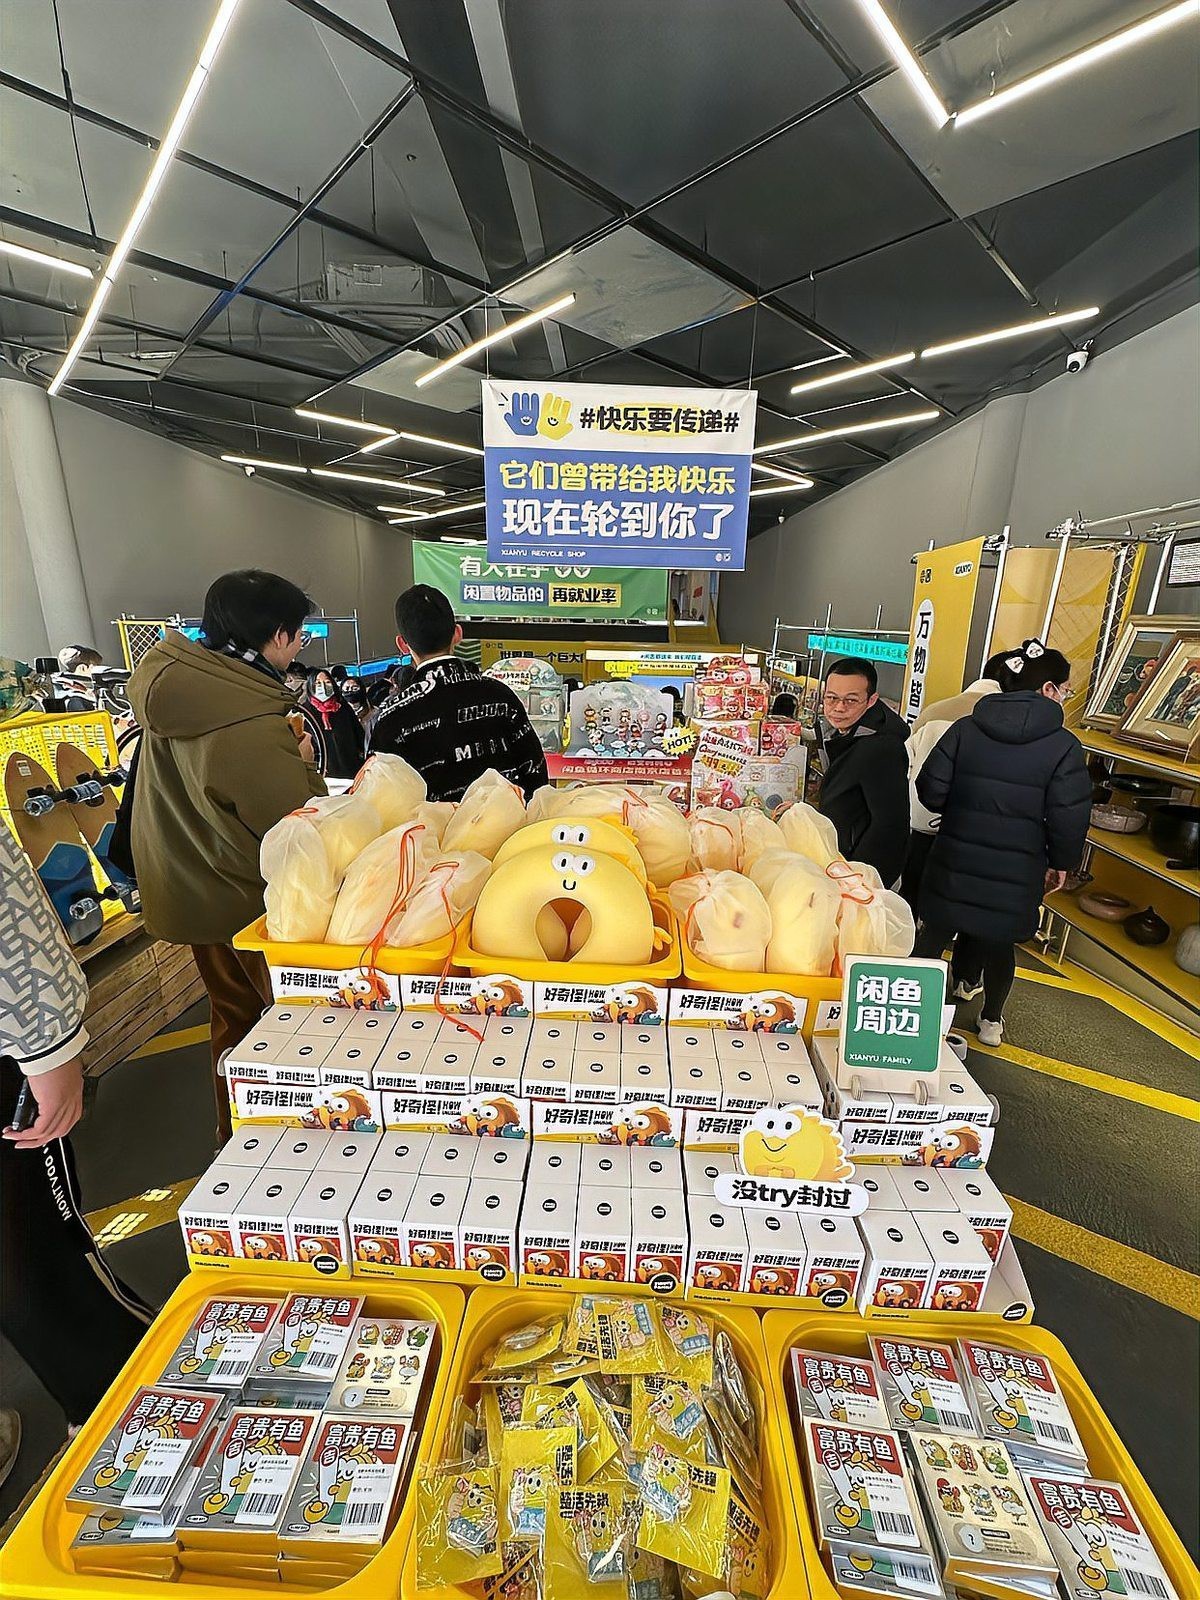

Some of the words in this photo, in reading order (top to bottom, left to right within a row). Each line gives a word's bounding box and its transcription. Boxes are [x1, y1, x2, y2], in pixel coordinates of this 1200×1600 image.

[580, 406, 740, 433] #快乐要传递#
[499, 460, 736, 495] 它们曾带给我快乐
[501, 499, 735, 540] 现在轮到你了
[501, 549, 527, 557] XIANYU
[531, 550, 563, 558] RECYCLE
[567, 550, 586, 558] SHOP
[464, 584, 544, 602] 闲置物品的
[552, 587, 617, 604] 再就业率
[667, 736, 692, 750] HOT!
[280, 972, 322, 988] 好奇怪!
[856, 974, 921, 1006] 闲鱼
[544, 987, 587, 1003] 好奇怪!
[680, 995, 724, 1011] 好奇怪!
[854, 1006, 920, 1037] 周边
[849, 1053, 879, 1062] XIANYU
[882, 1056, 912, 1065] FAMILY
[246, 1090, 292, 1107] 好奇怪!
[393, 1098, 442, 1115] 好奇怪!
[544, 1108, 593, 1125] 好奇怪!
[851, 1128, 902, 1146] 好奇怪!
[732, 1180, 853, 1209] 没try封过
[206, 1303, 269, 1322] 富贵有鱼
[290, 1298, 352, 1316] 富贵有鱼
[880, 1343, 948, 1369] 富贵有鱼
[971, 1347, 1046, 1379] 富贵有鱼
[803, 1358, 870, 1388] 富贵有鱼
[134, 1395, 206, 1423] 富贵有鱼
[232, 1416, 305, 1441] 富贵有鱼
[325, 1425, 397, 1450] 富贵有鱼
[817, 1428, 894, 1460] 富贵有鱼
[1038, 1481, 1126, 1517] 富贵有鱼
